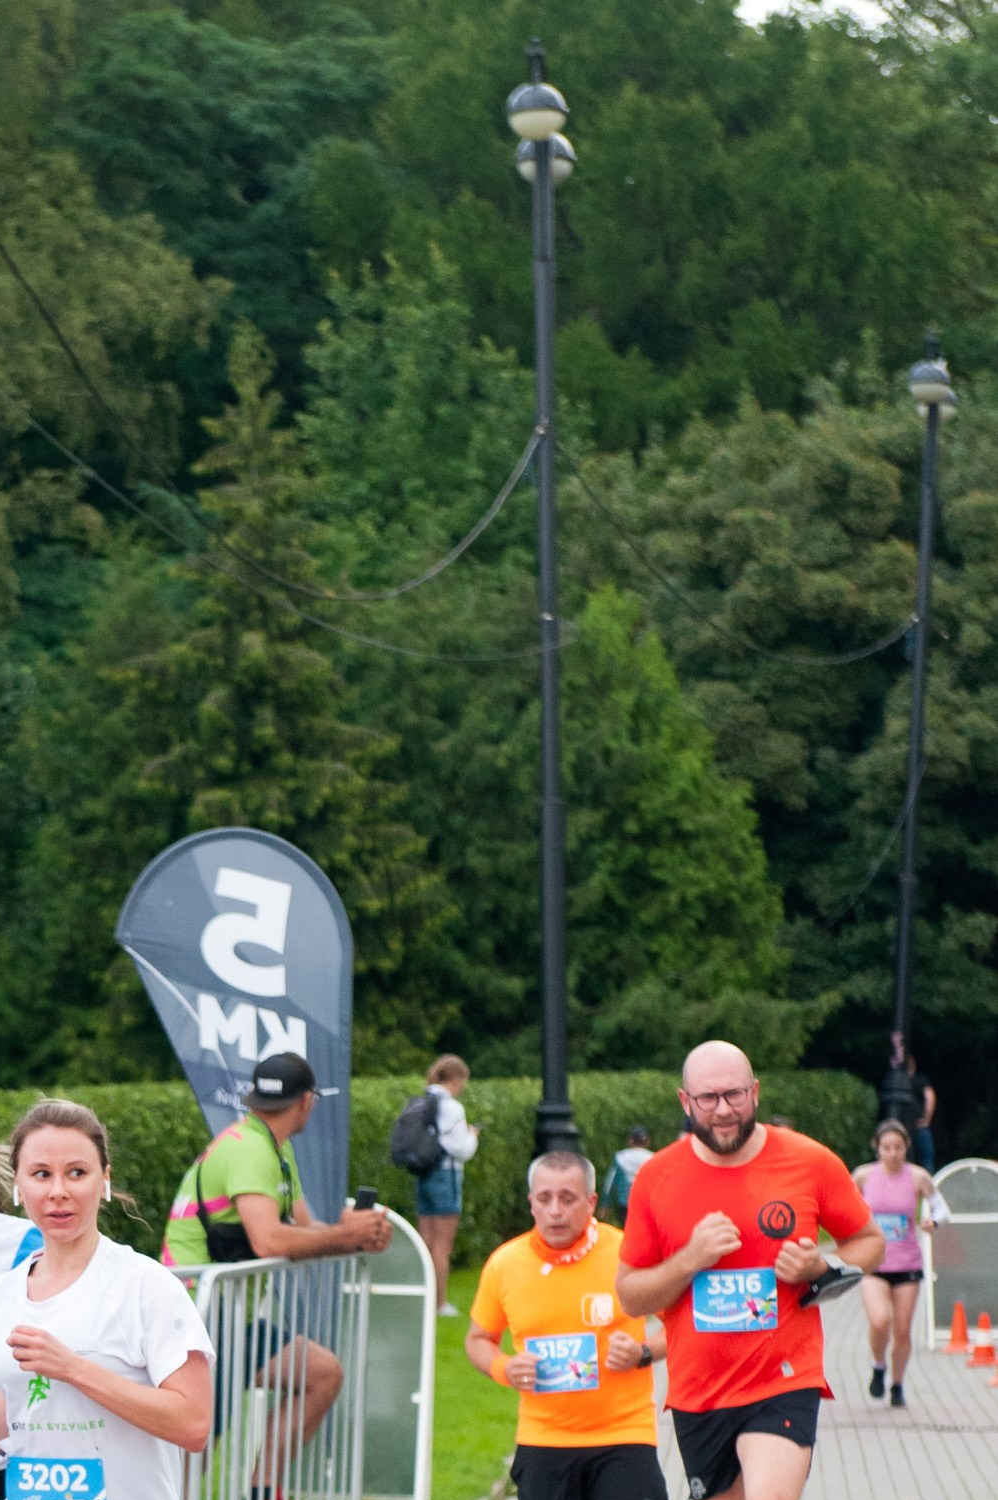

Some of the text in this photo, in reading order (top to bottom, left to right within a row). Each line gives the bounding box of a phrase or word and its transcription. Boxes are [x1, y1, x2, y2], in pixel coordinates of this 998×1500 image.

[707, 1272, 762, 1295] 3316
[536, 1338, 582, 1360] 3157
[18, 1463, 89, 1492] 3202
